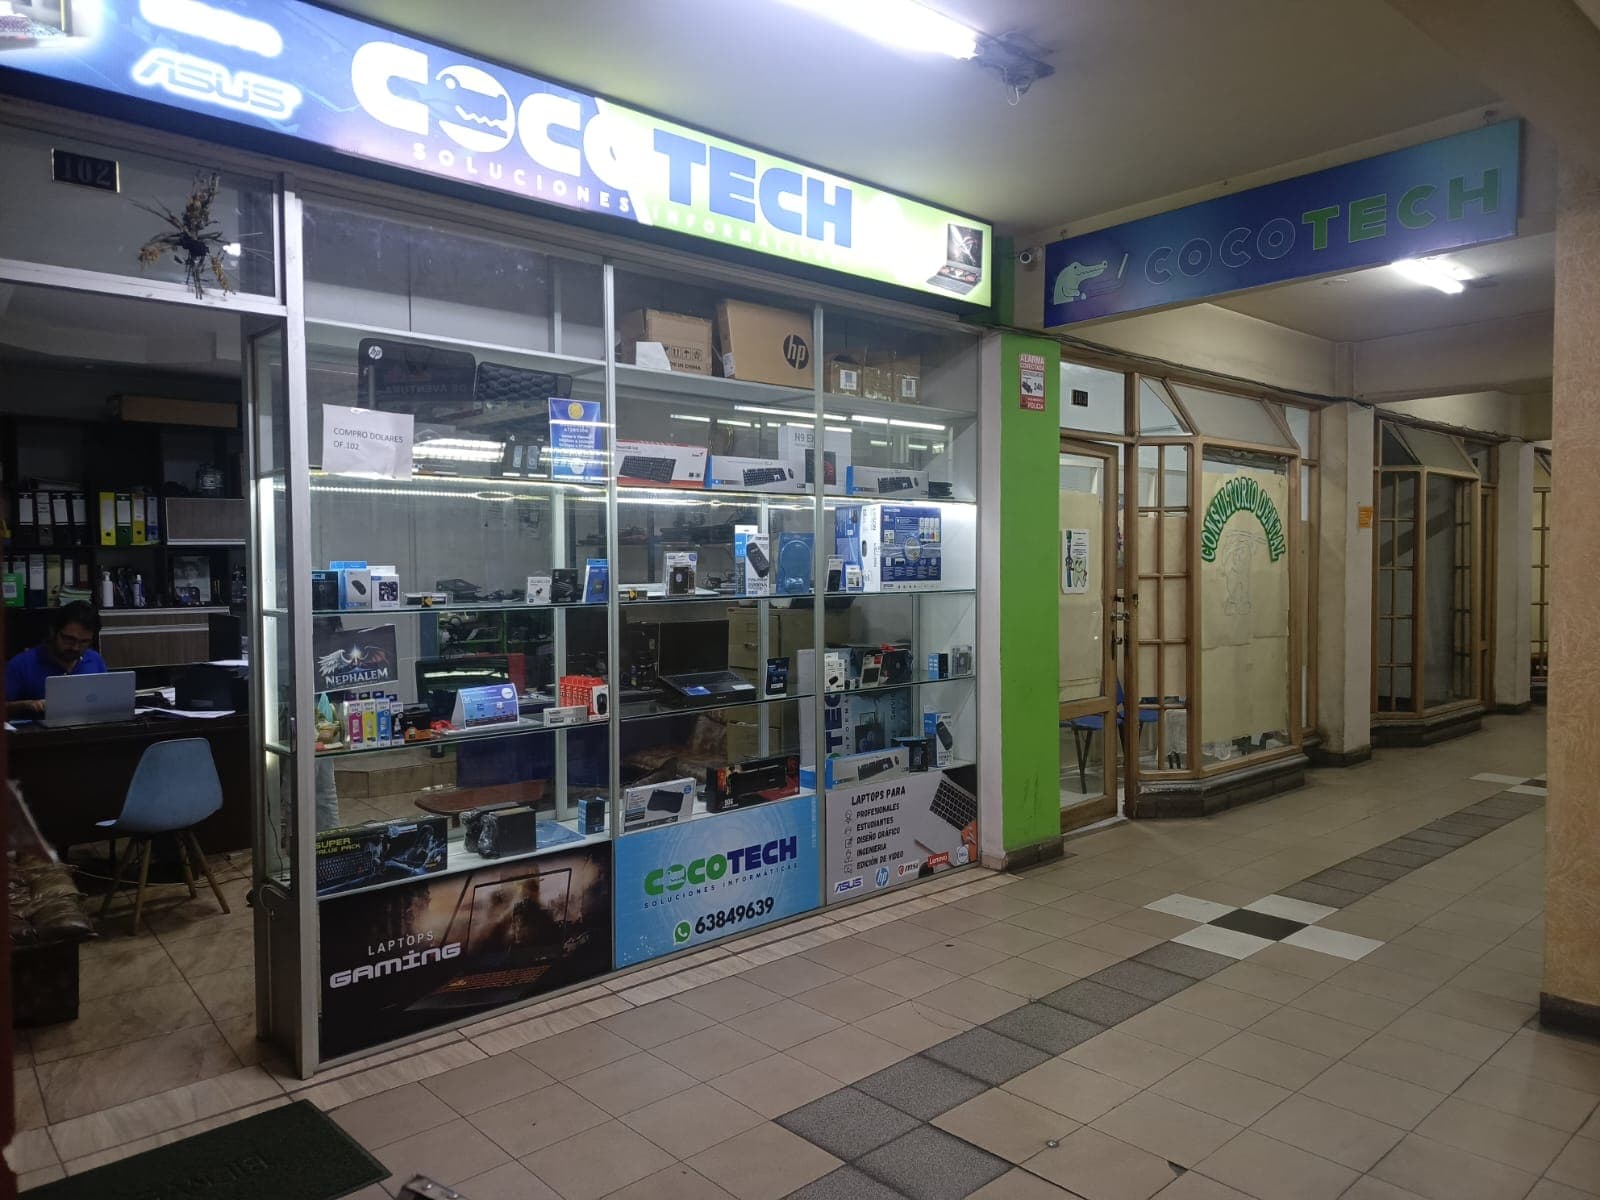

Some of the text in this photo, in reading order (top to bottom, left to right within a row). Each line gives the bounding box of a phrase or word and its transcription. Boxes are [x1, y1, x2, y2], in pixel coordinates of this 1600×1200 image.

[138, 52, 294, 114] ASUS
[64, 158, 111, 187] 102
[413, 143, 631, 212] SOLUCIONES
[786, 335, 808, 369] hp
[333, 427, 404, 444] COMPRO DOLARES
[1200, 476, 1286, 563] CONSULTORIO DENTAL
[325, 667, 389, 689] NEPHALEM
[851, 785, 906, 806] LAPTOPS PARA
[856, 802, 900, 819] PROFESIONALES
[856, 816, 894, 832] ESTUDIANTES
[315, 837, 351, 849] SUPER
[856, 832, 877, 845] DISEÑO
[879, 854, 886, 864] DE
[888, 850, 904, 862] VIDEO
[835, 877, 862, 893] ASUS
[876, 867, 889, 887] hp
[644, 884, 716, 909] SOLUCIONES
[694, 896, 775, 935] 63849639
[368, 930, 434, 956] LAPTOPS
